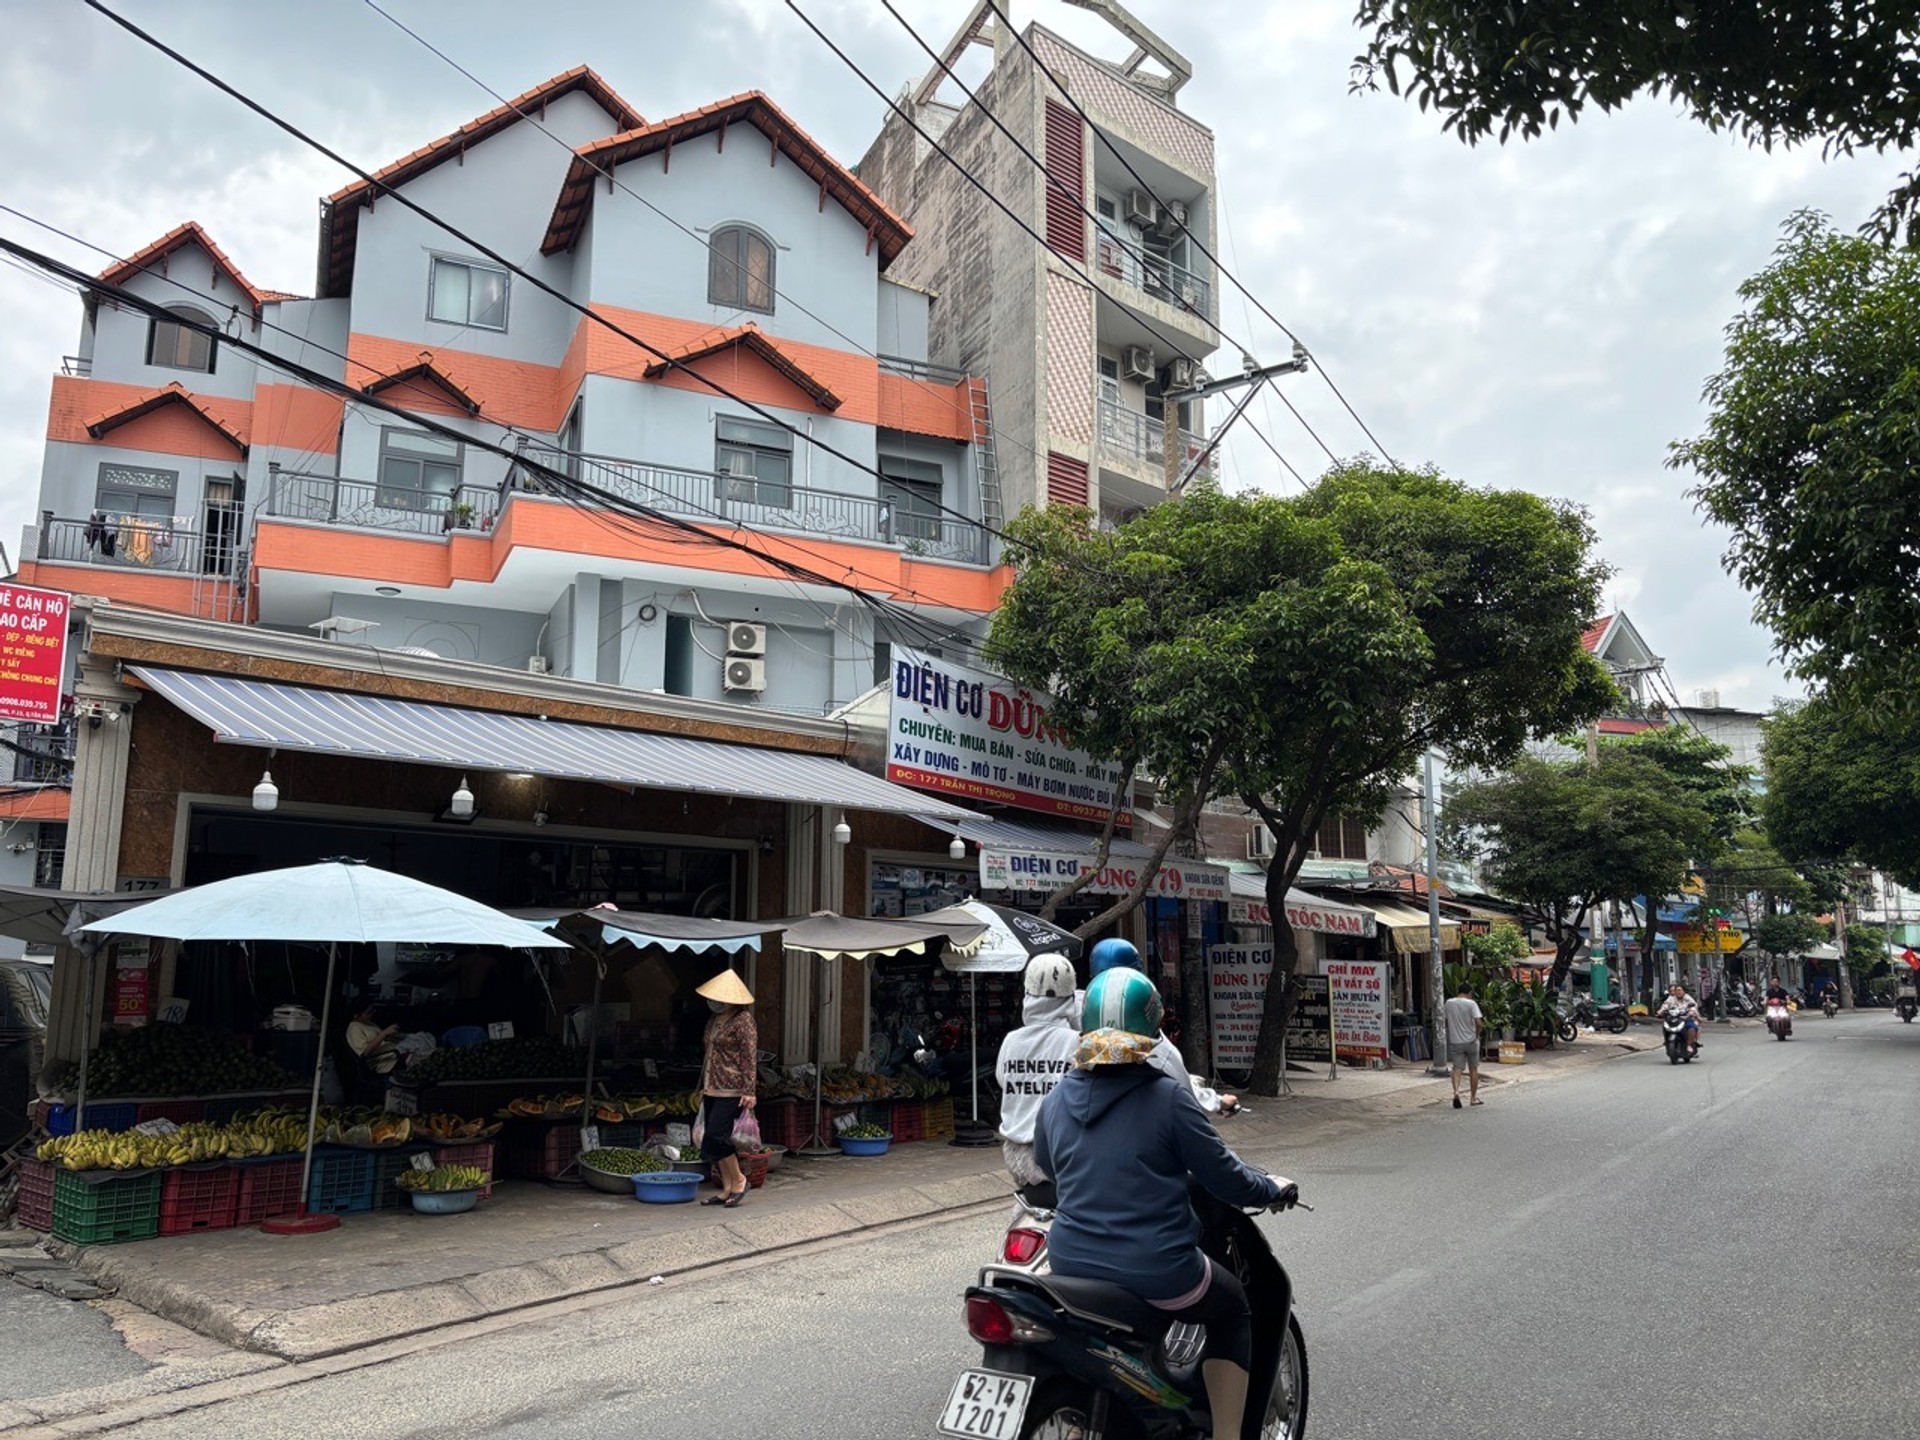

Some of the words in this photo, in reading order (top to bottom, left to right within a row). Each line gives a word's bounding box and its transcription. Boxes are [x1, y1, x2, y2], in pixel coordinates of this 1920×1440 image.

[16, 593, 43, 611] CĂN
[45, 597, 64, 617] HỘ
[21, 612, 48, 631] CẤP
[897, 660, 950, 714] ĐIỆN
[956, 679, 983, 720] CƠ
[899, 716, 957, 746] CHUYÊN:
[960, 733, 987, 754] MUA
[990, 739, 1014, 760] BÁN
[1024, 747, 1047, 768] SỬA
[1049, 756, 1077, 775] CHỮA
[1086, 764, 1107, 782] MÁY
[894, 742, 922, 763] XÂY
[924, 749, 959, 772] DỰNG
[971, 760, 990, 779] MÔ
[993, 767, 1008, 782] TƠ
[1017, 771, 1041, 790] MÁY
[1043, 777, 1066, 796] BƠM
[1068, 782, 1095, 801] NƯỚC
[1097, 787, 1110, 804] ĐỦ
[896, 769, 917, 781] ĐC:
[919, 774, 938, 785] 177
[1010, 854, 1052, 878] ĐIỆN
[1056, 859, 1078, 876] CƠ
[1325, 913, 1362, 933] NAM
[1212, 948, 1247, 968] ĐIỆN
[1251, 948, 1272, 964] CƠ
[1213, 970, 1249, 987] DŨNG
[1351, 965, 1376, 976] MAY
[1214, 991, 1237, 1000] KHOAN
[953, 1403, 1007, 1438] 1201
